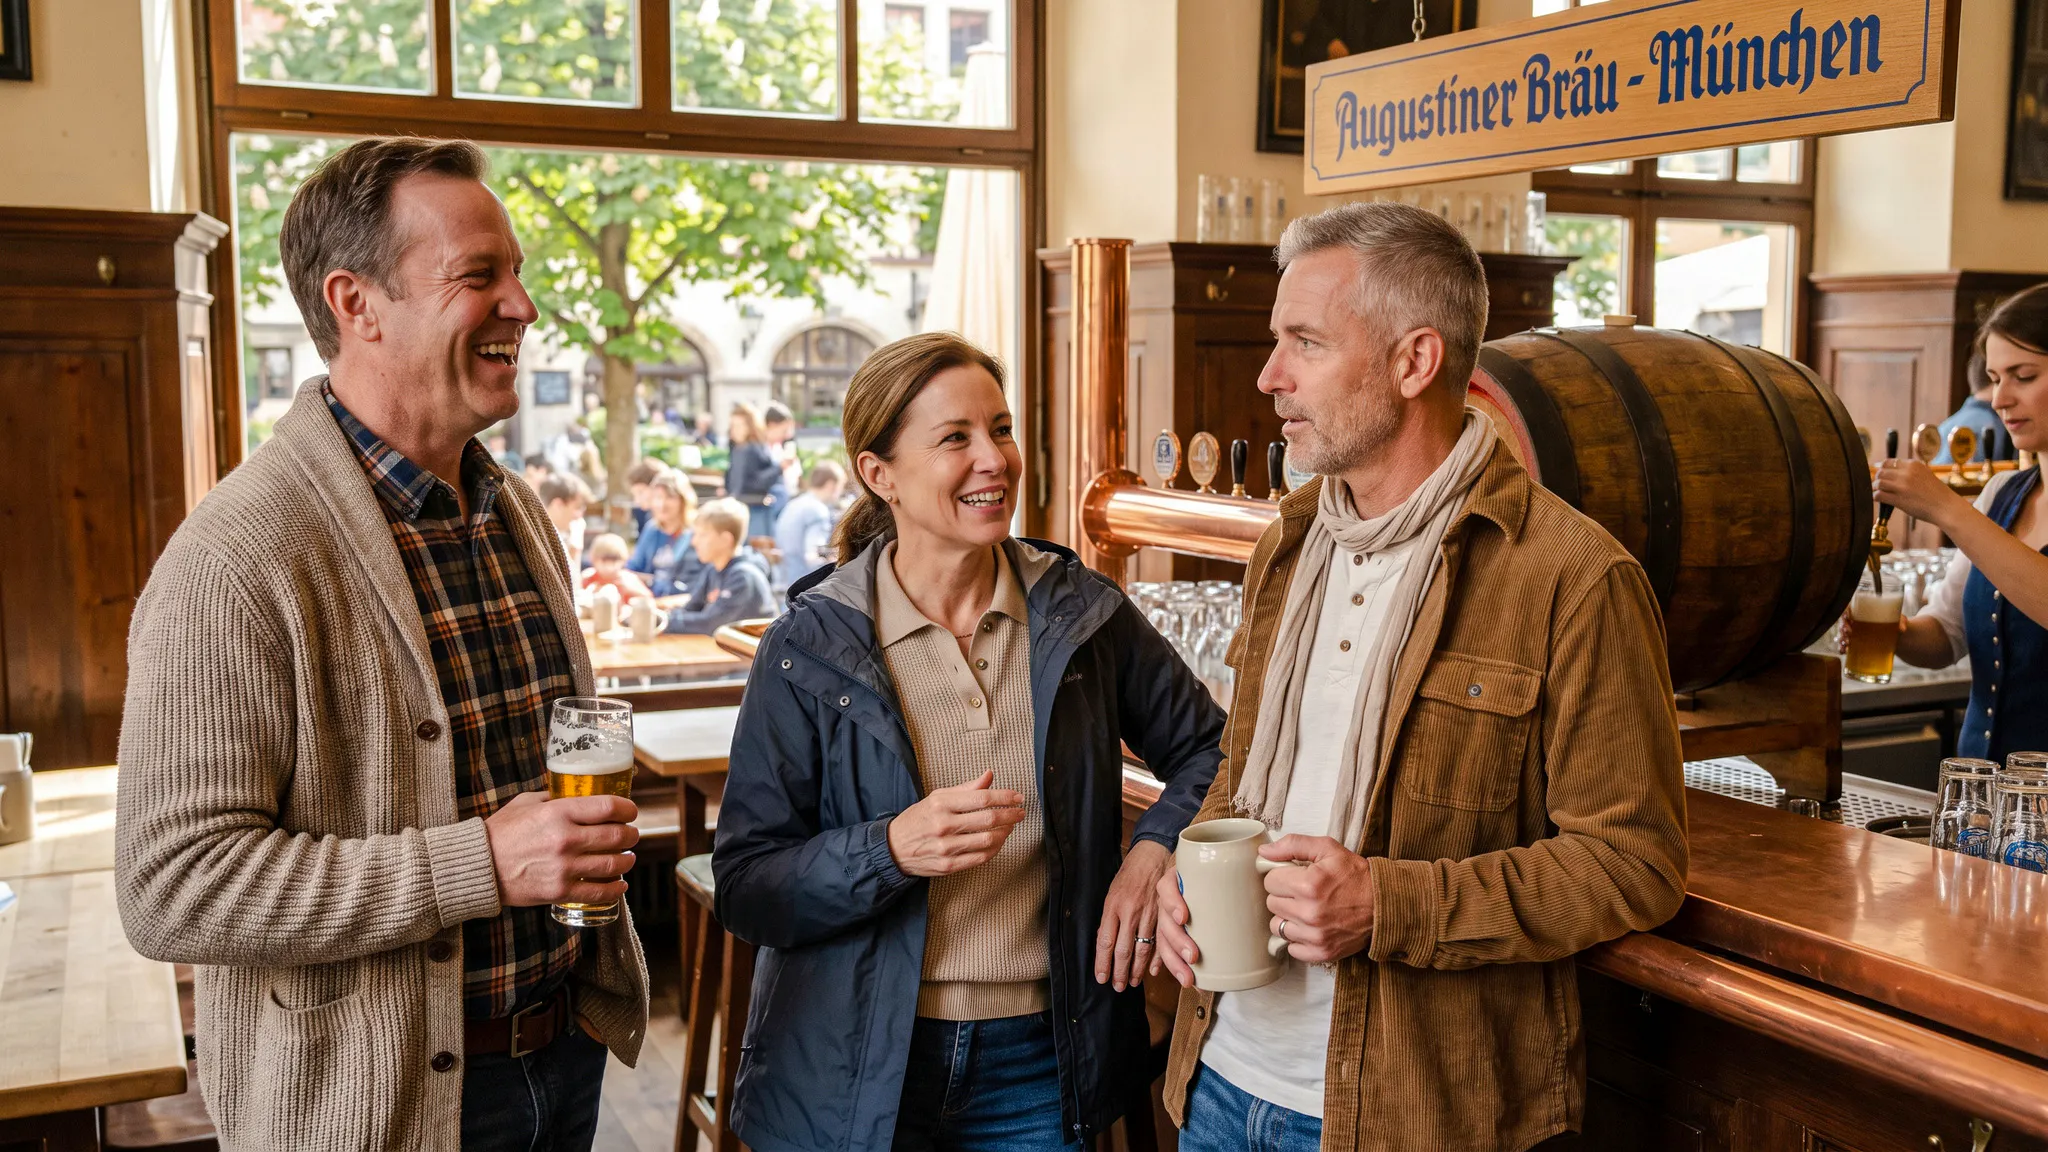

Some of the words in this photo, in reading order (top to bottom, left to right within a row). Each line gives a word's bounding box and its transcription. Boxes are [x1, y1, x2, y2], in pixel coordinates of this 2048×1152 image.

[1335, 74, 1518, 162] Augustiner
[1522, 48, 1619, 124] Bräu
[1649, 8, 1884, 104] München
